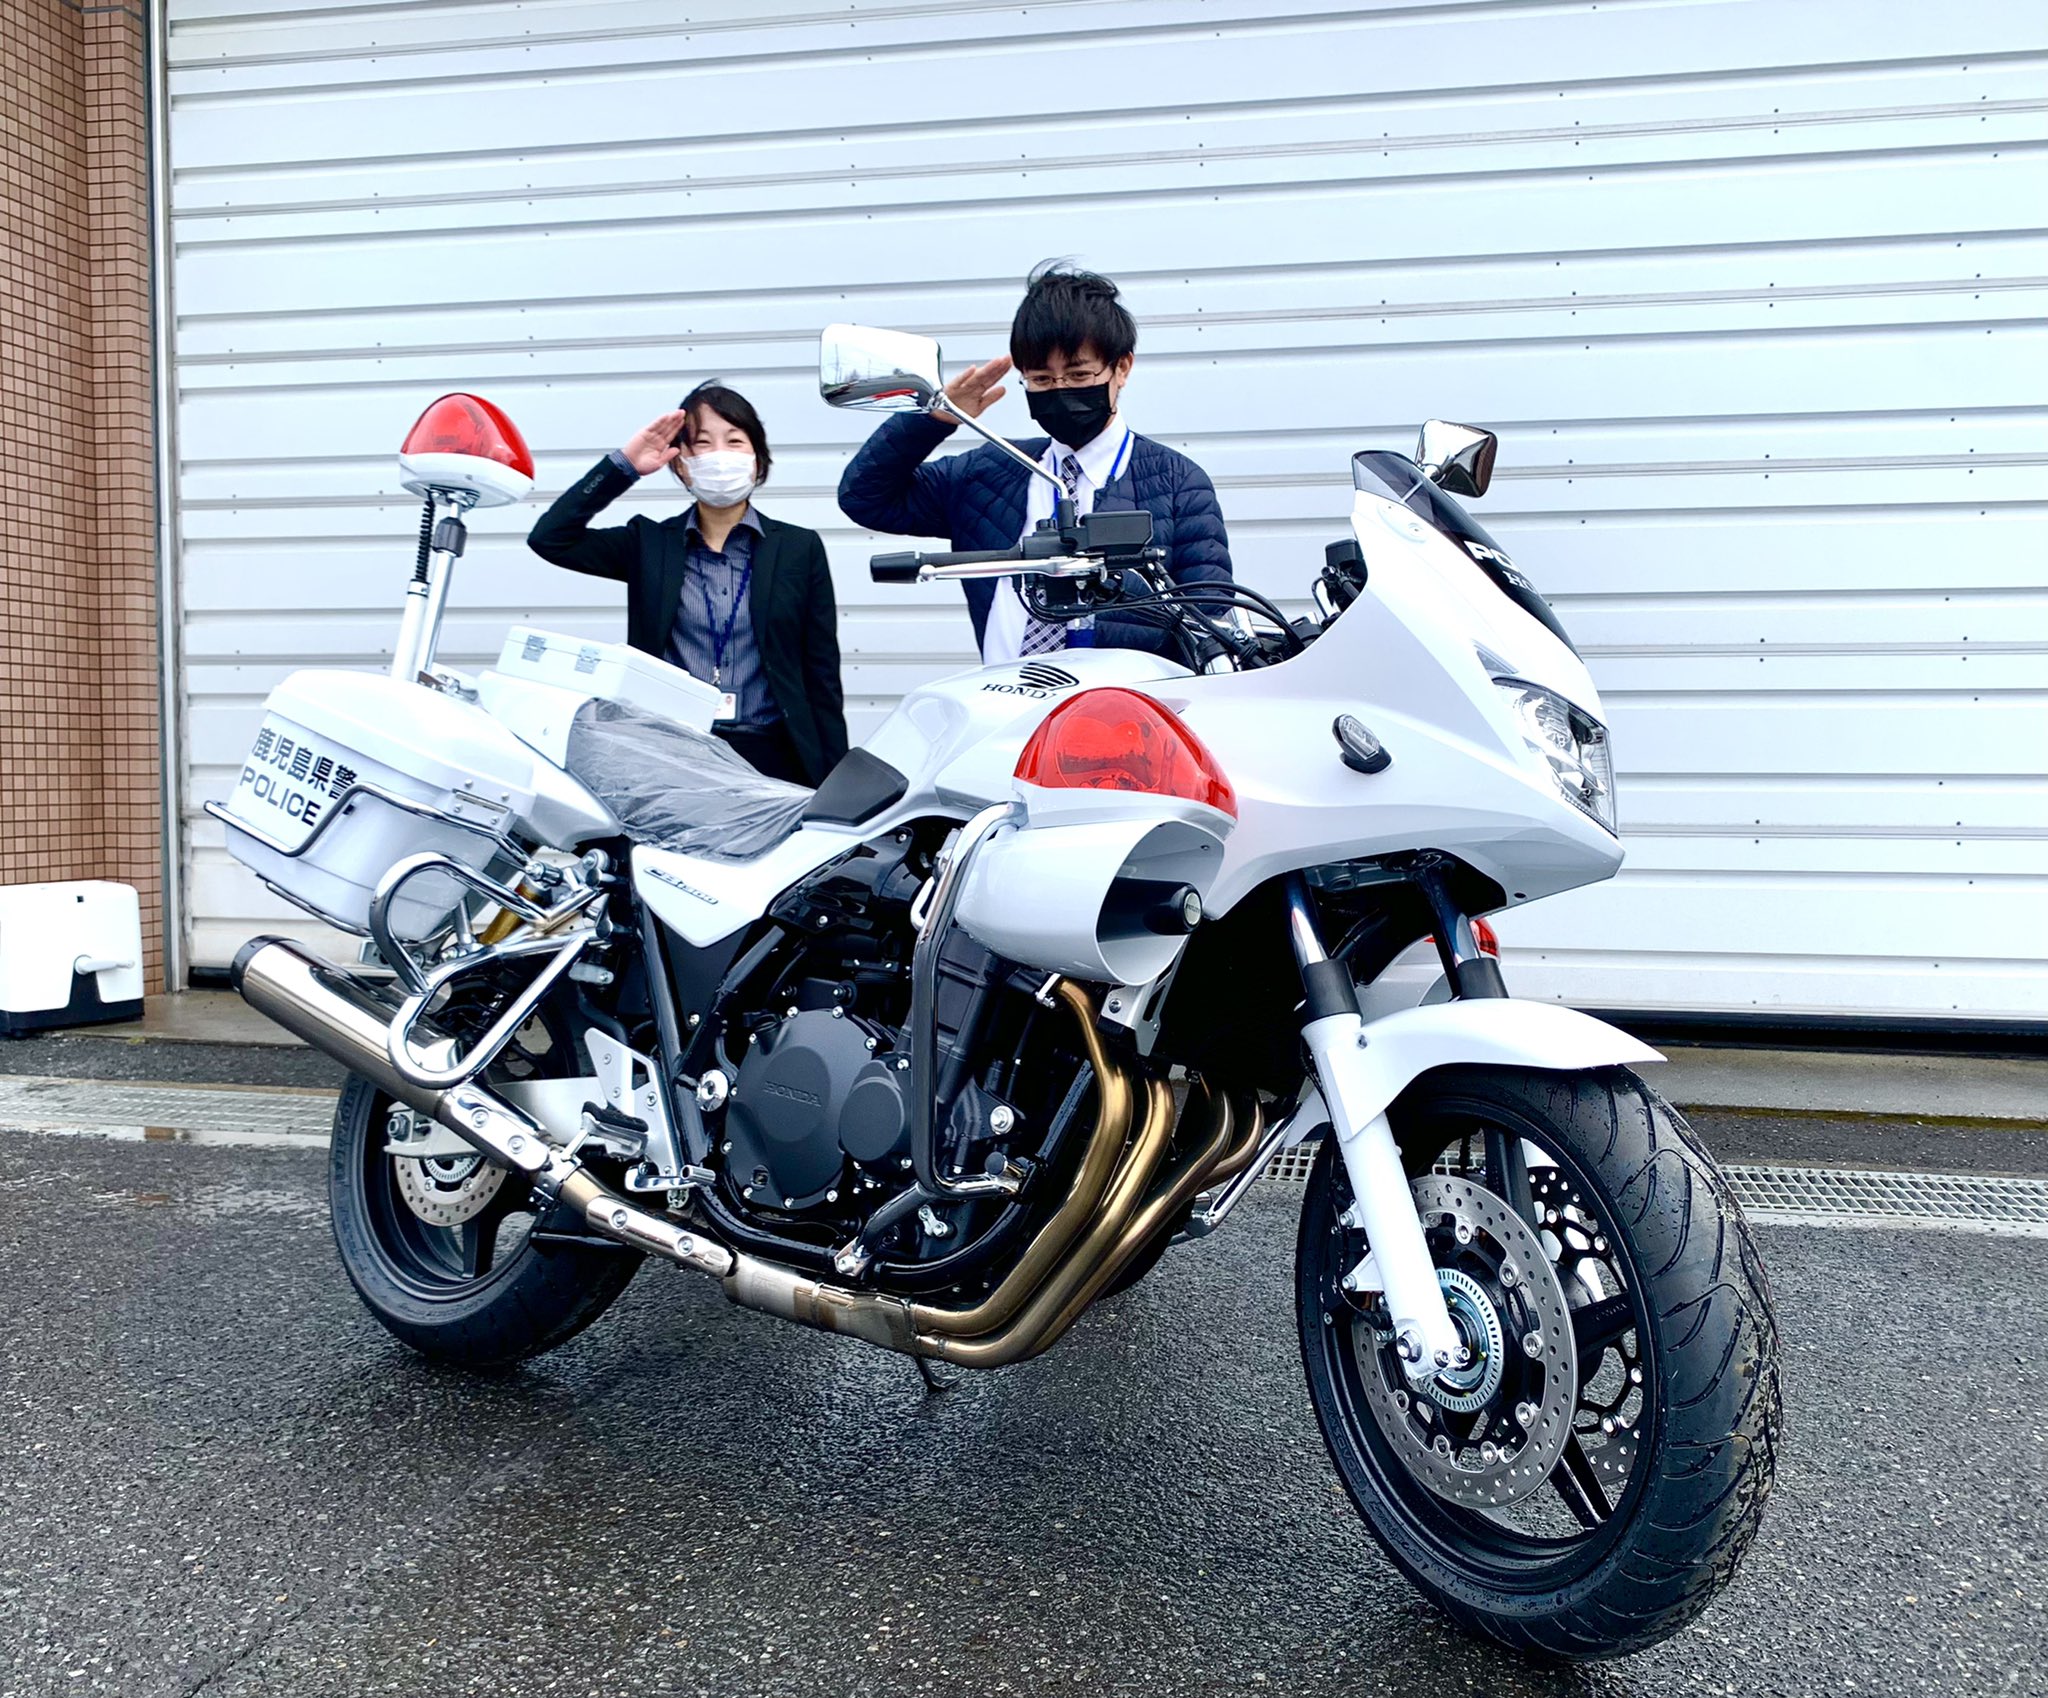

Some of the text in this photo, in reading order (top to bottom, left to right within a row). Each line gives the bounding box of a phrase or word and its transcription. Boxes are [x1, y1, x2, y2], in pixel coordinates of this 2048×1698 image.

[251, 727, 359, 800] 鹿児島県警
[239, 766, 322, 827] POLICE
[762, 1080, 822, 1107] HONDA
